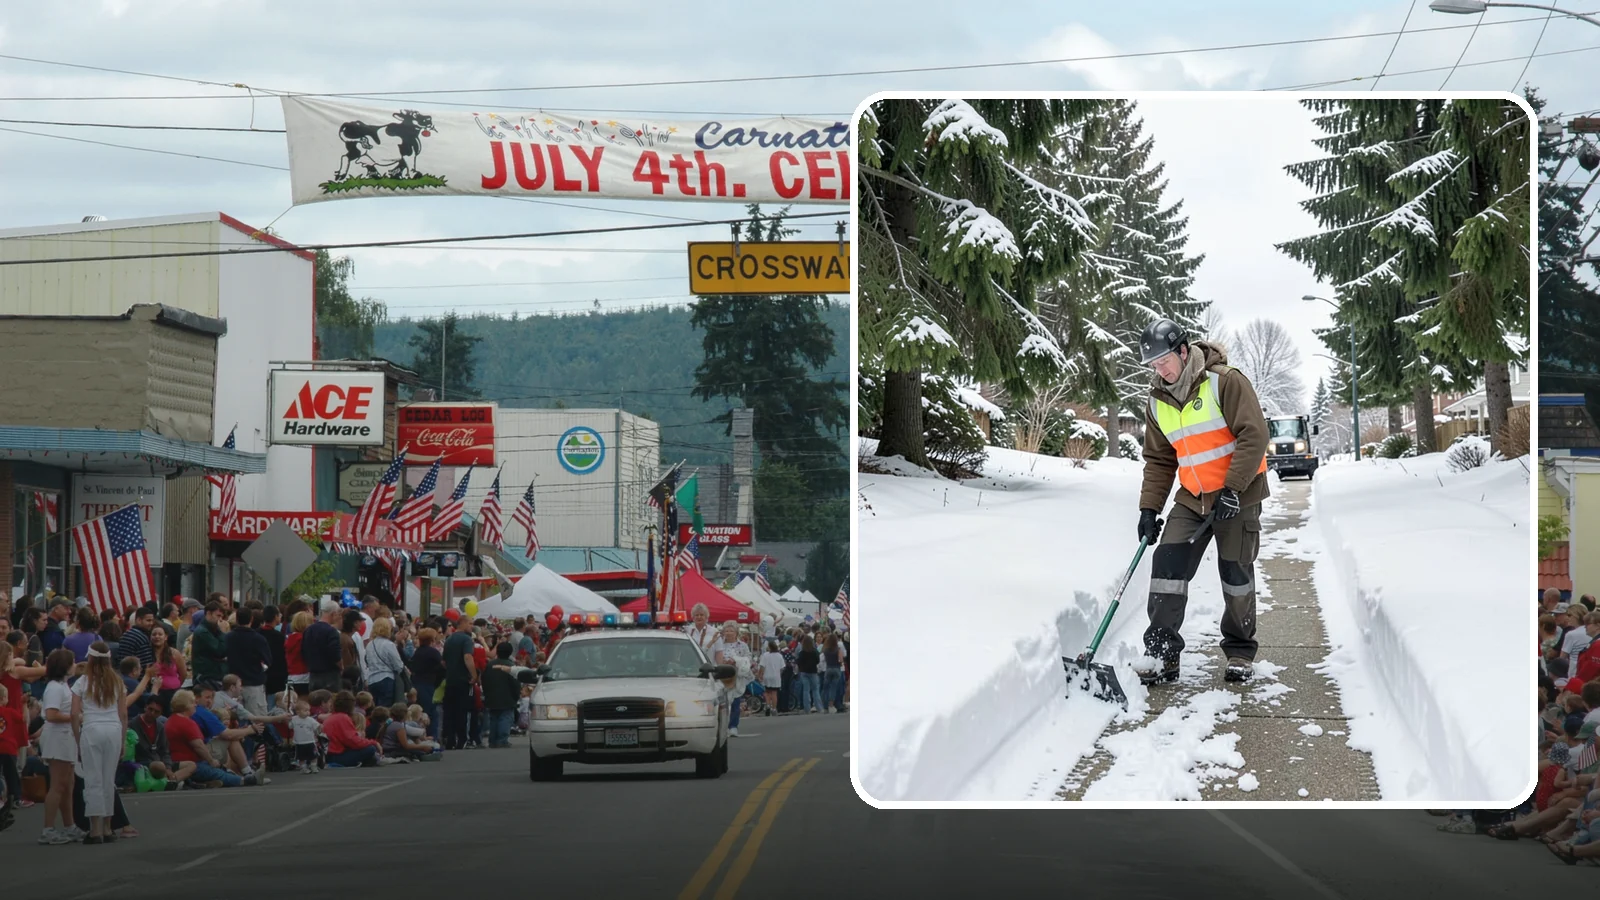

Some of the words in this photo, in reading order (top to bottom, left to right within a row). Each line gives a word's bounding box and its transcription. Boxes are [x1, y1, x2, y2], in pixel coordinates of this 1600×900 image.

[481, 141, 605, 192] JULY
[632, 150, 746, 198] 4th.
[696, 254, 850, 280] CROSSWA
[282, 380, 374, 420] ACE
[405, 409, 452, 422] CEDAR
[461, 409, 485, 422] LOG
[283, 421, 371, 437] Hardware
[416, 428, 477, 447] Coca-Cola
[353, 467, 384, 481] Simpl
[95, 485, 125, 495] Vincent
[126, 485, 136, 494] de
[137, 486, 155, 495] Paul
[212, 516, 331, 536] HARDARE
[688, 526, 741, 535] CRNATION
[699, 535, 730, 543] GLASS
